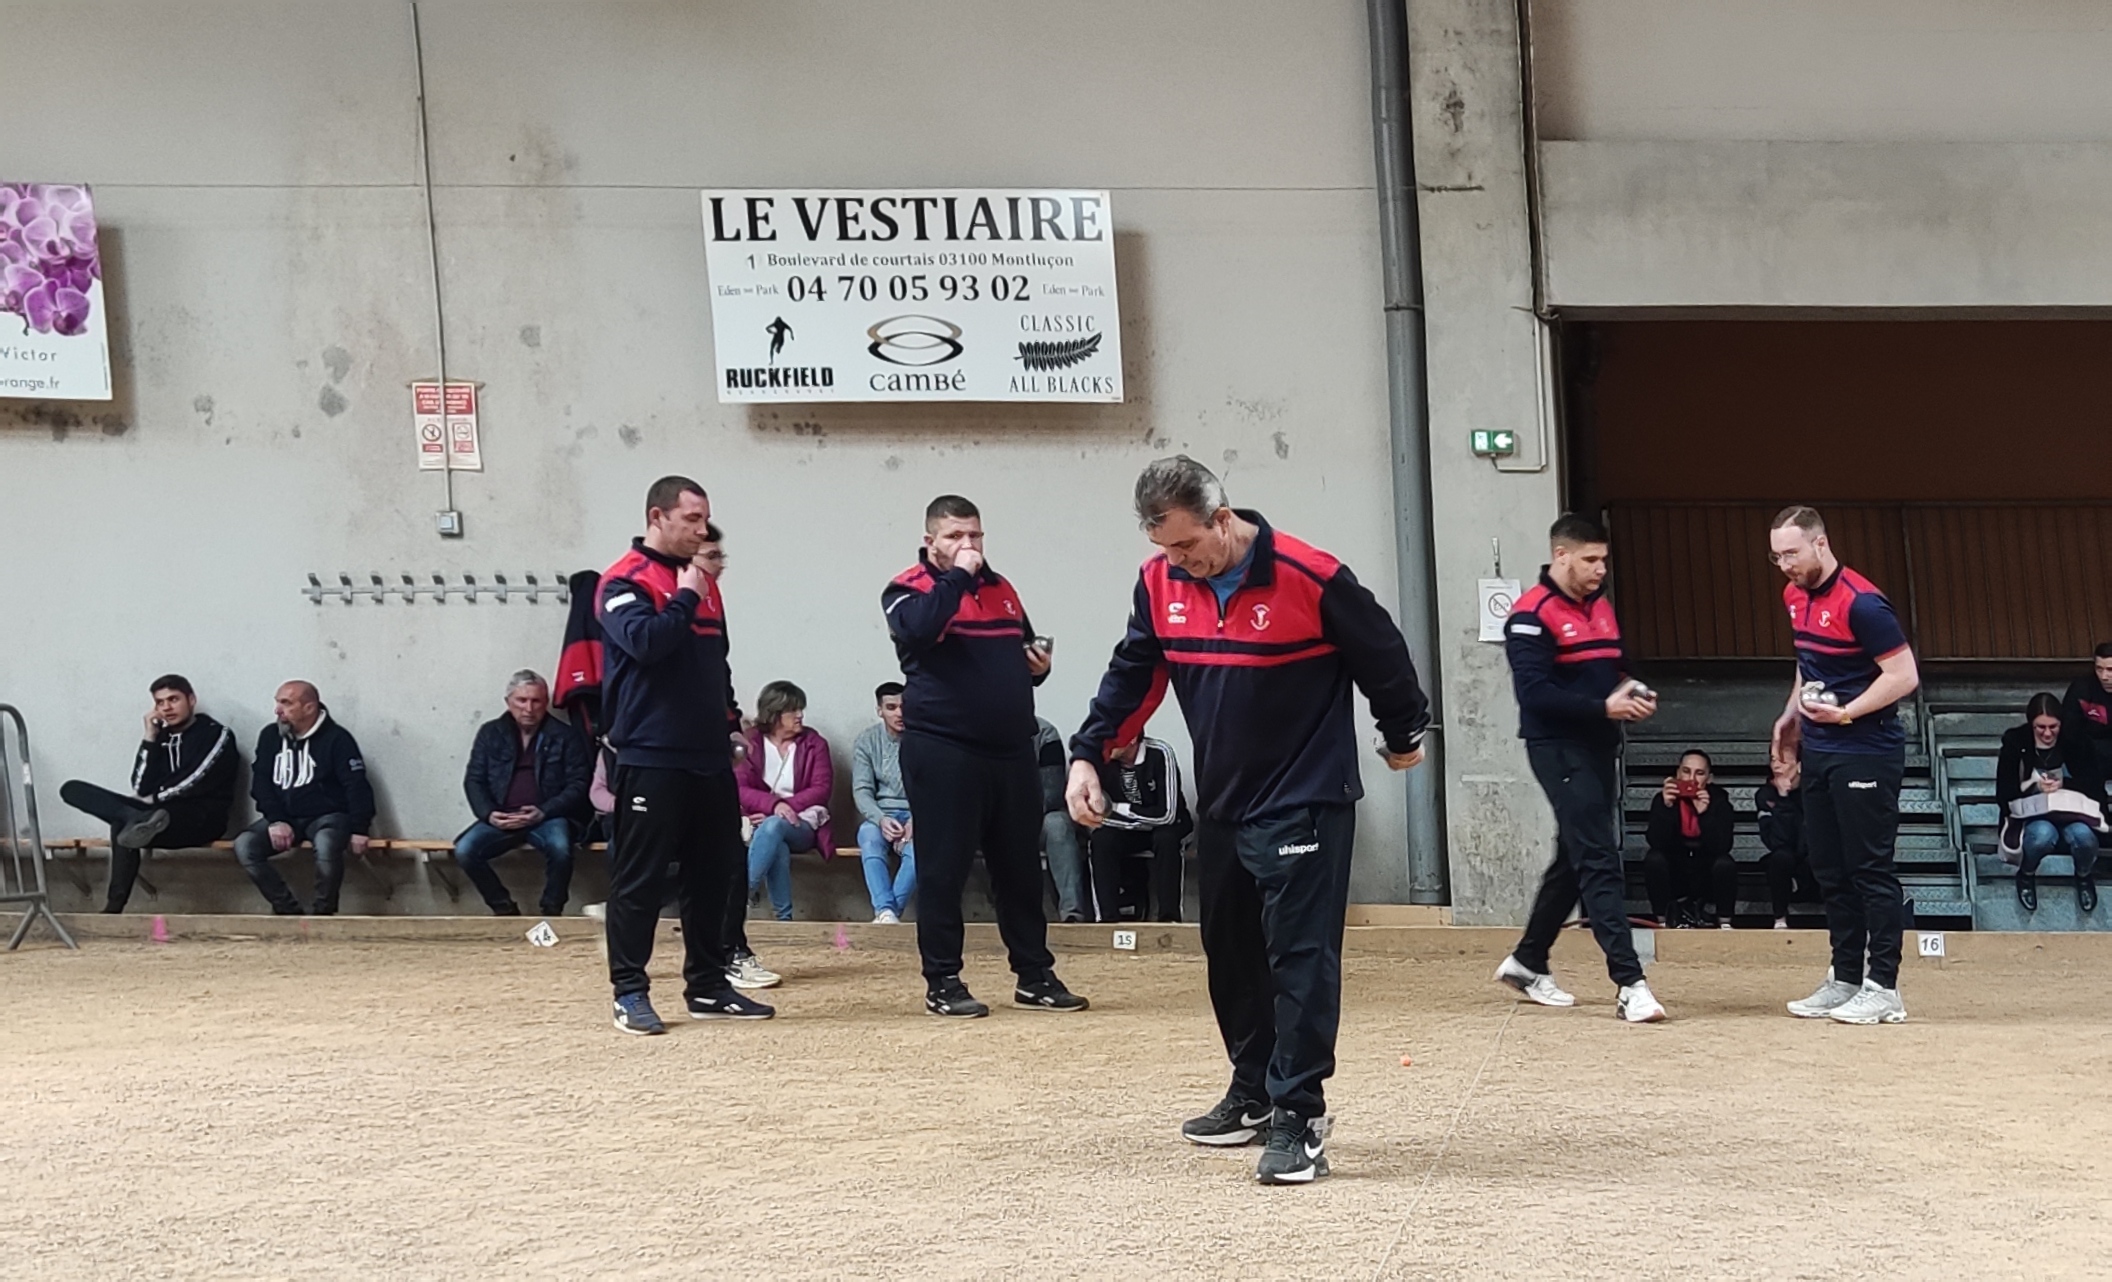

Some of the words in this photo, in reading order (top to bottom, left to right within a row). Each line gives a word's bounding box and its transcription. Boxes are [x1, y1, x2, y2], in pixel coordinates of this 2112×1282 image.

[708, 196, 778, 242] LE
[791, 196, 1104, 242] VESTIAIRE
[746, 253, 756, 270] 1
[767, 252, 846, 267] Boulevard
[850, 252, 869, 267] de
[872, 252, 935, 267] courtais
[938, 252, 988, 267] 03100
[991, 252, 1075, 269] Montluçon
[717, 284, 742, 297] Eden
[755, 284, 779, 297] Park
[786, 274, 828, 303] 04
[837, 274, 878, 302] 70
[888, 274, 929, 302] 05
[938, 274, 980, 302] 93
[990, 274, 1031, 302] 02
[1042, 283, 1067, 296] Eden
[1081, 284, 1105, 298] Park
[1020, 314, 1096, 333] CLASSIC
[725, 366, 835, 389] RUCKFIELD
[1008, 375, 1041, 394] ALL
[1047, 375, 1115, 394] BLACKS
[1278, 842, 1319, 856] uhlsport
[1921, 937, 1940, 952] 16
